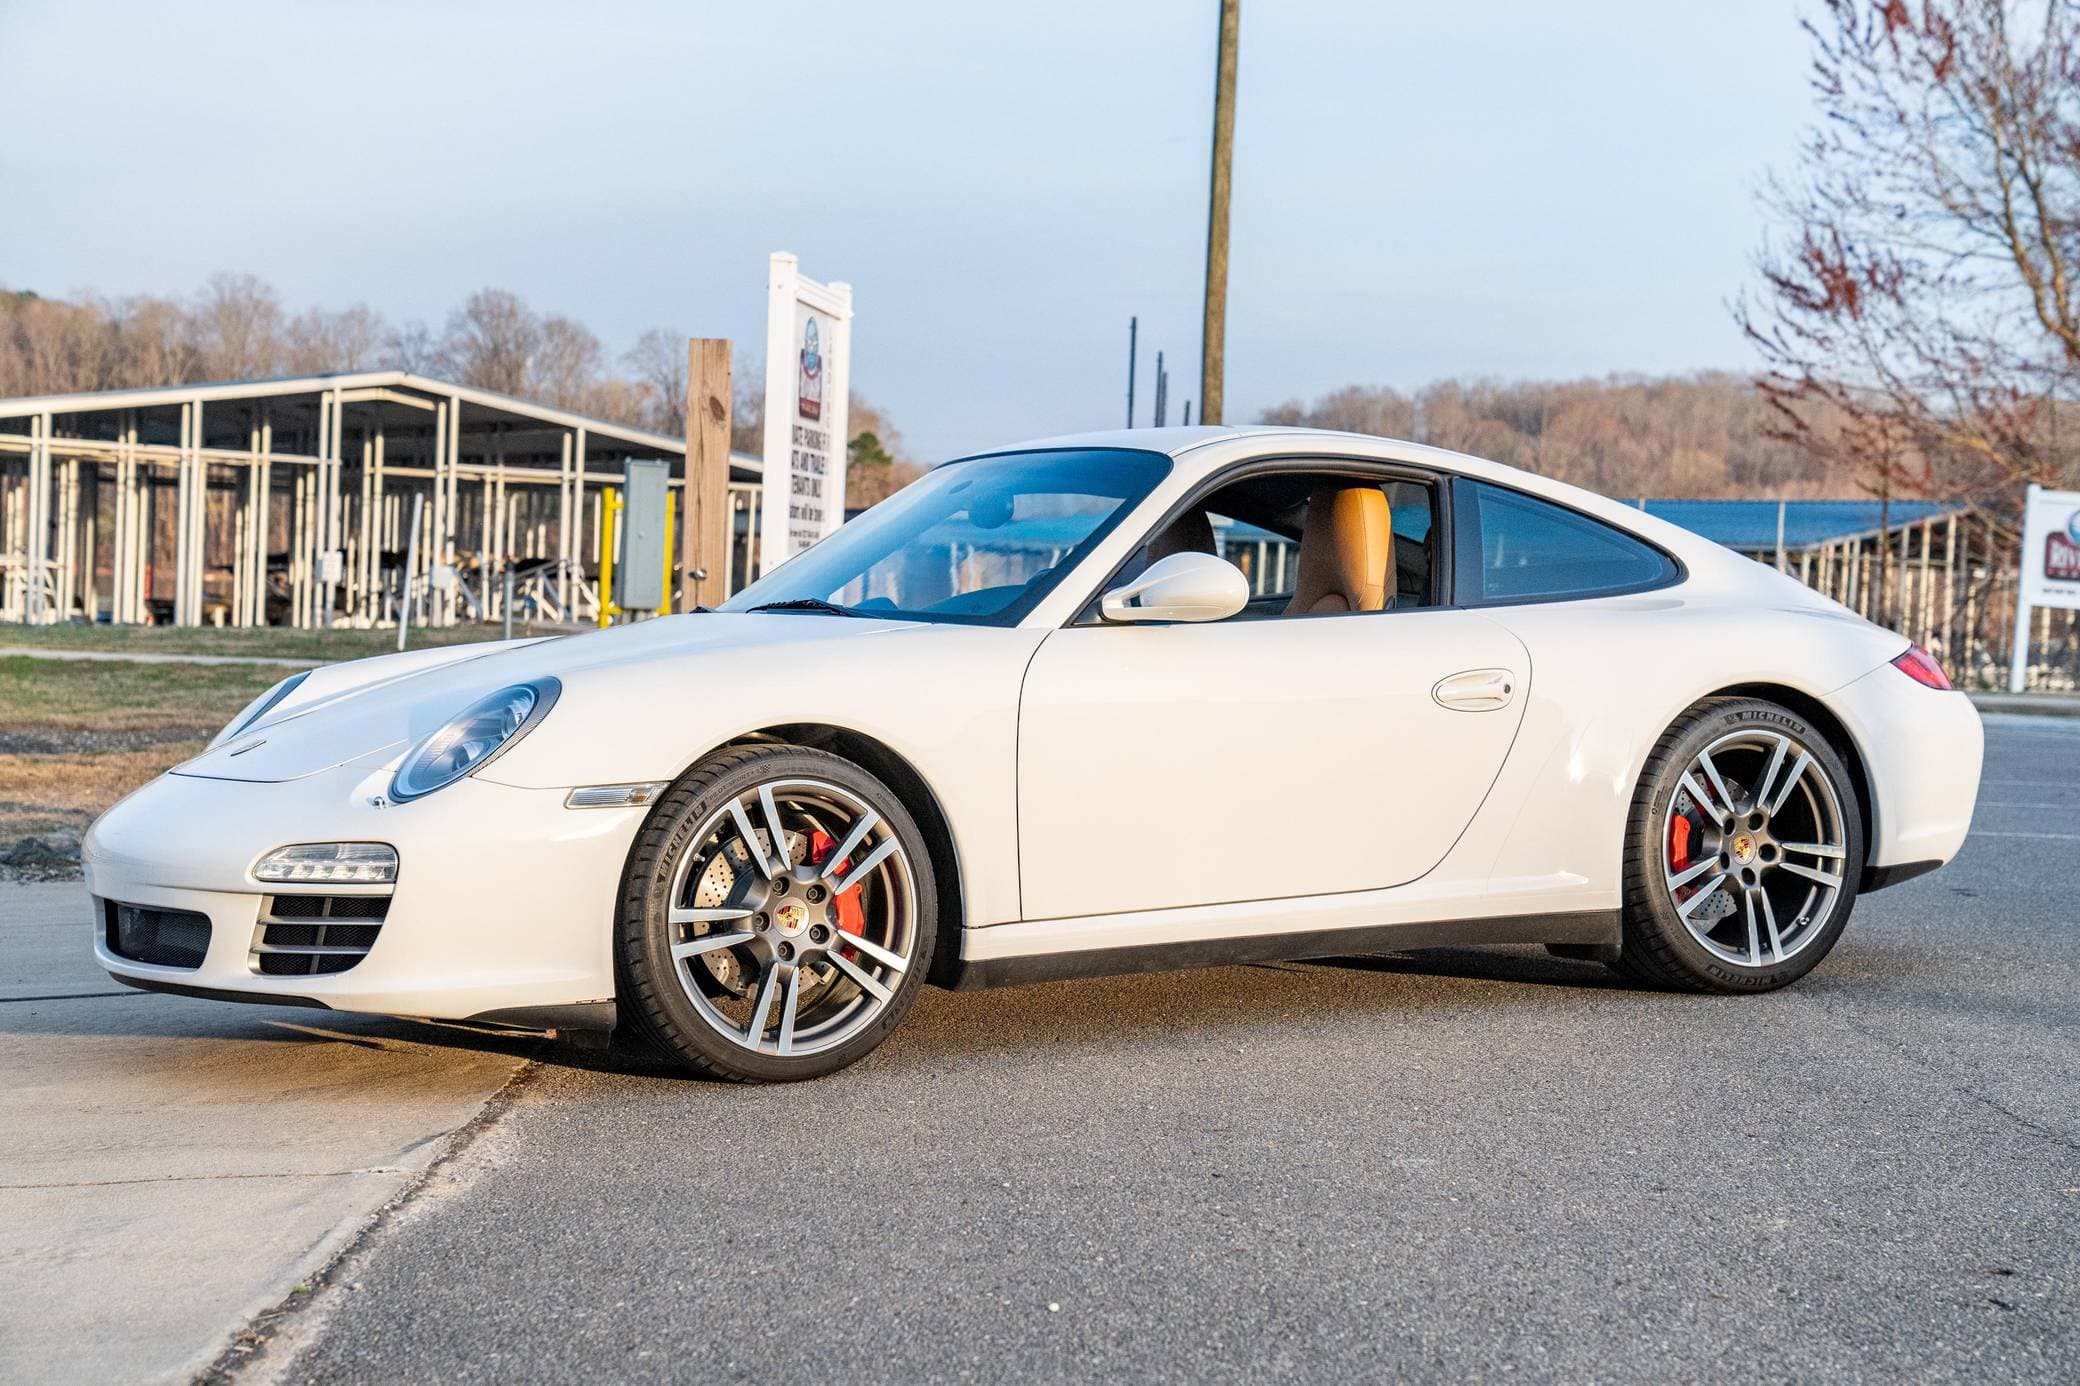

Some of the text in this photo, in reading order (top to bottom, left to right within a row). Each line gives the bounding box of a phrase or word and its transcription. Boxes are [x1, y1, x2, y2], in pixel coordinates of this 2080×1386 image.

[1741, 711, 1802, 733] MICHELIN
[659, 803, 706, 875] MICHELIN
[1709, 965, 1773, 986] MICHELIN
